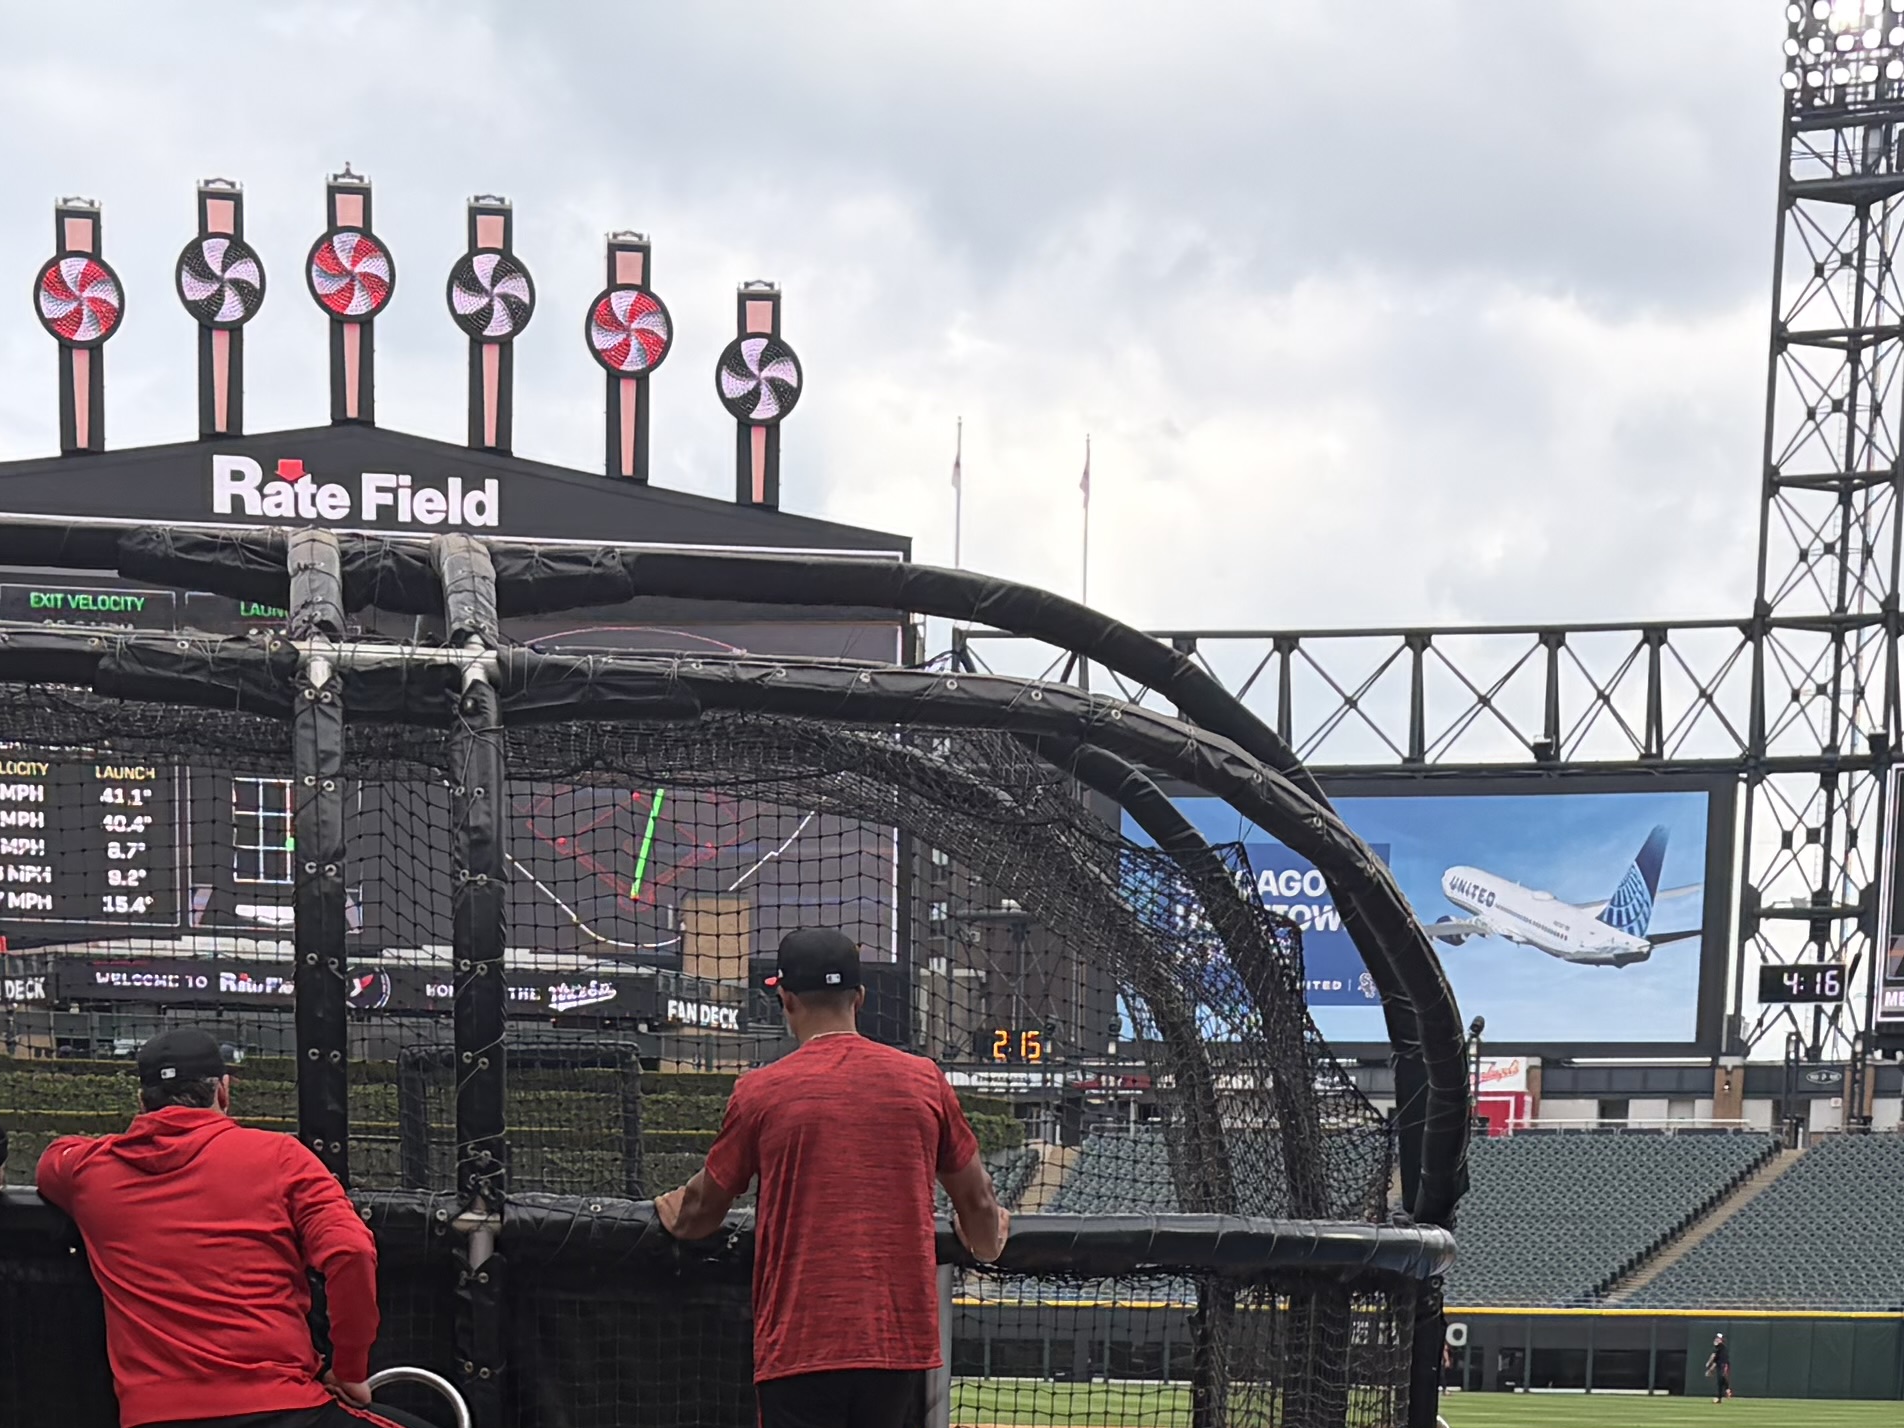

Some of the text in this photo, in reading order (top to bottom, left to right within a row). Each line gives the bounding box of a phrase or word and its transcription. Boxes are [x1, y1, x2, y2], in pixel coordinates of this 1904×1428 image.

[212, 455, 499, 527] Rate Field
[30, 591, 145, 612] EXIT VELOCITY
[240, 601, 291, 617] LAUN
[96, 765, 156, 780] LAUNCH
[0, 783, 44, 803] MPH
[0, 810, 44, 828] MPH
[0, 838, 45, 856] MPH
[7, 864, 52, 884] MPH
[8, 892, 53, 911] MPH
[5, 976, 46, 1000] DECK
[1782, 969, 1841, 997] 4:16
[667, 1000, 739, 1031] FAN DECK
